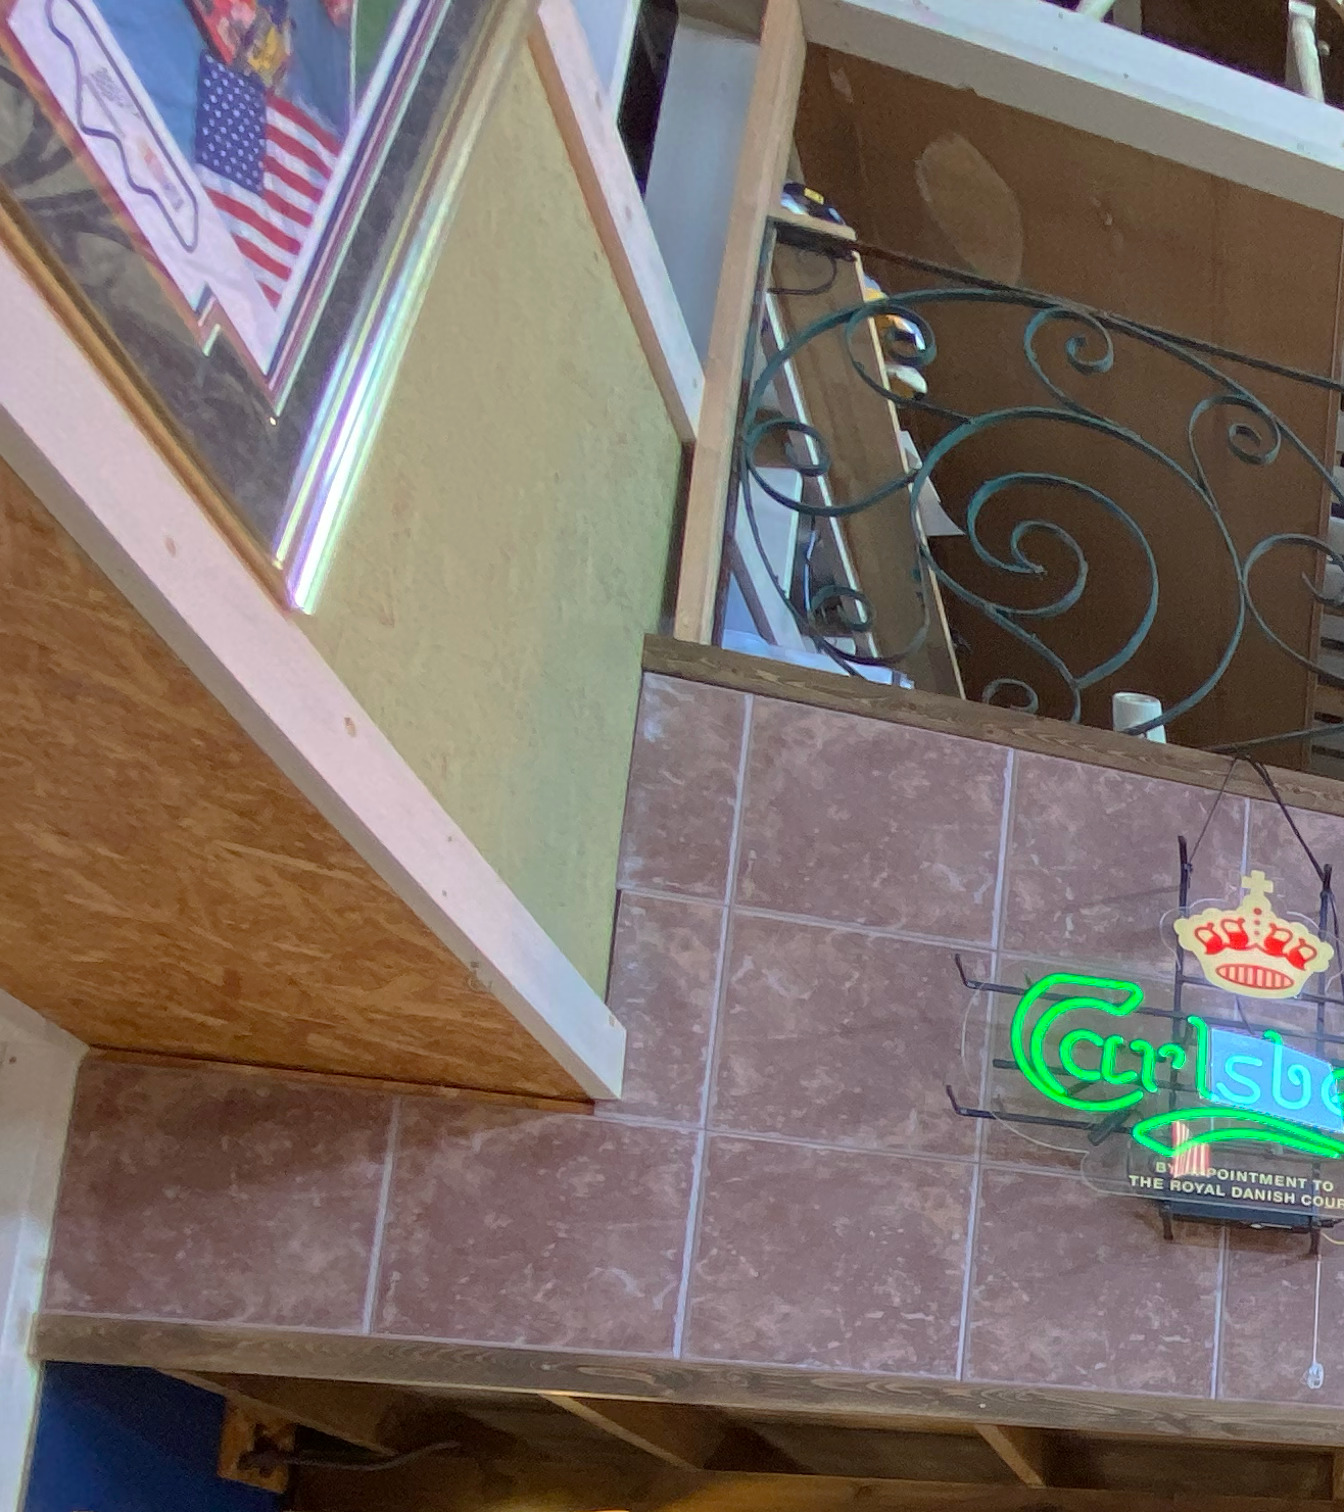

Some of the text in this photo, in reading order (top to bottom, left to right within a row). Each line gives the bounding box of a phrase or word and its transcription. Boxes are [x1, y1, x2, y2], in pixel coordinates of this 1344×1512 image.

[1128, 1174, 1164, 1190] THE
[1169, 1180, 1226, 1198] ROYAL
[1231, 1187, 1296, 1205] DANISH
[1189, 1165, 1307, 1189] POINTMENT
[1312, 1179, 1334, 1193] TO
